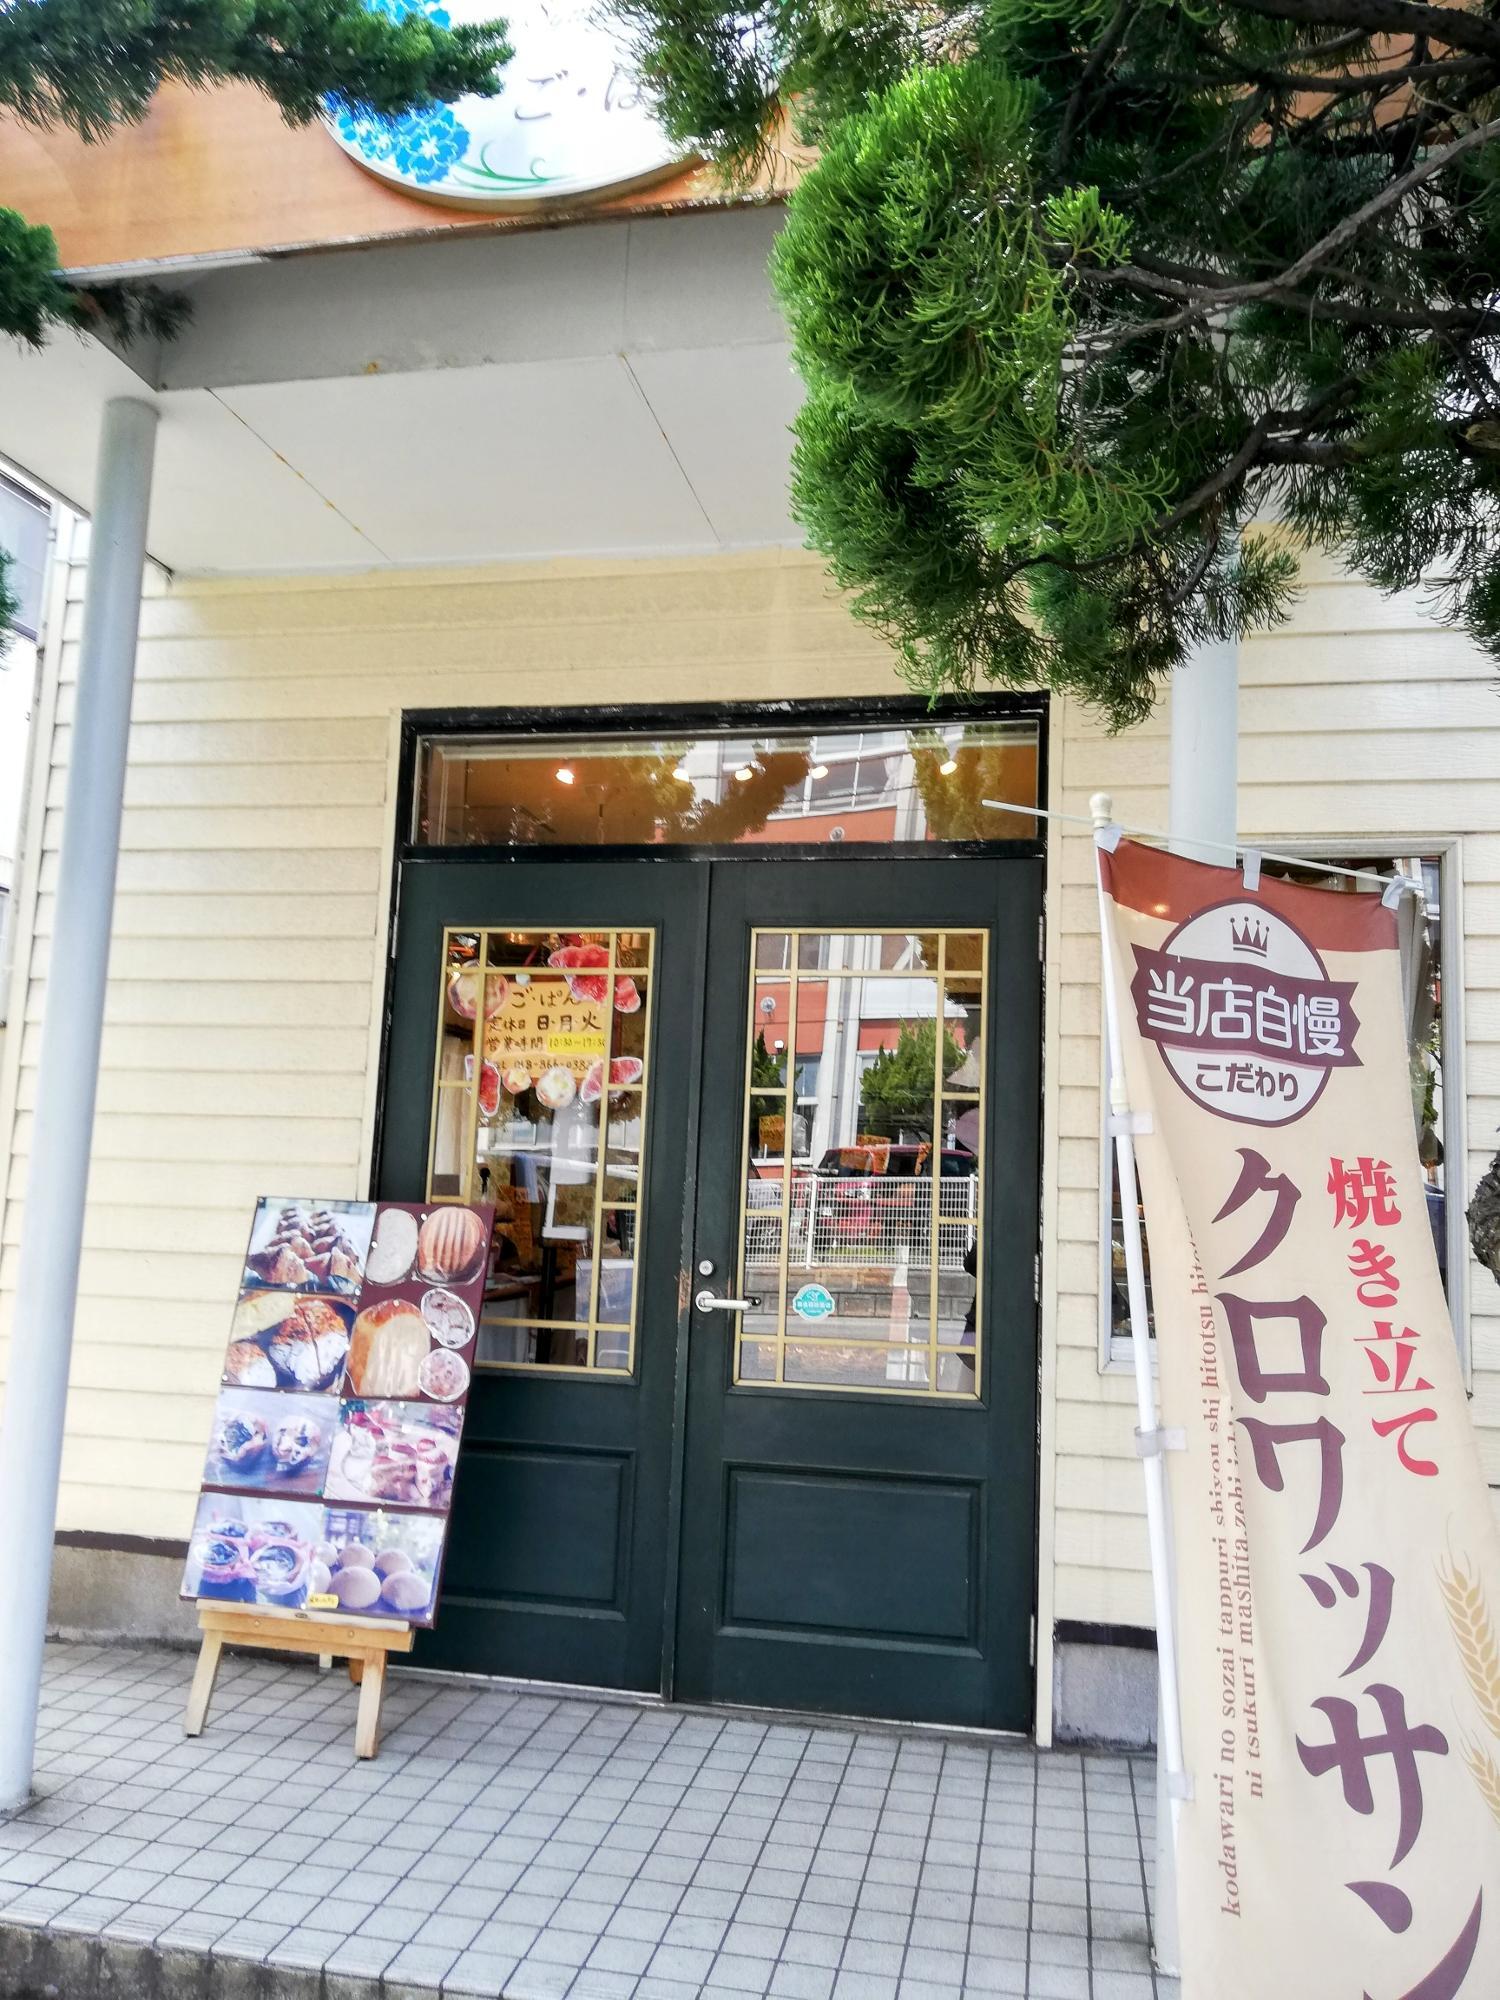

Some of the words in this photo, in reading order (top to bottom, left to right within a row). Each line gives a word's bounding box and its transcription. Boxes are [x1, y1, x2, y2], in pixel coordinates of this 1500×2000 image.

[1146, 967, 1346, 1058] 当店自慢
[1195, 1062, 1299, 1102] こだわり
[1199, 1304, 1220, 1390] hitotsu
[1326, 1156, 1440, 1477] 焼き立て
[1202, 1398, 1221, 1433] shi
[1208, 1443, 1226, 1527] shiyou
[1211, 1147, 1483, 2000] クロワッサン
[1212, 1536, 1234, 1637] tappuri
[1216, 1646, 1236, 1719] sozai
[1239, 1655, 1261, 1760] tsukuri
[1220, 1728, 1236, 1764] no
[1245, 1769, 1264, 1800] ni
[1213, 1772, 1241, 1918] kodawari
